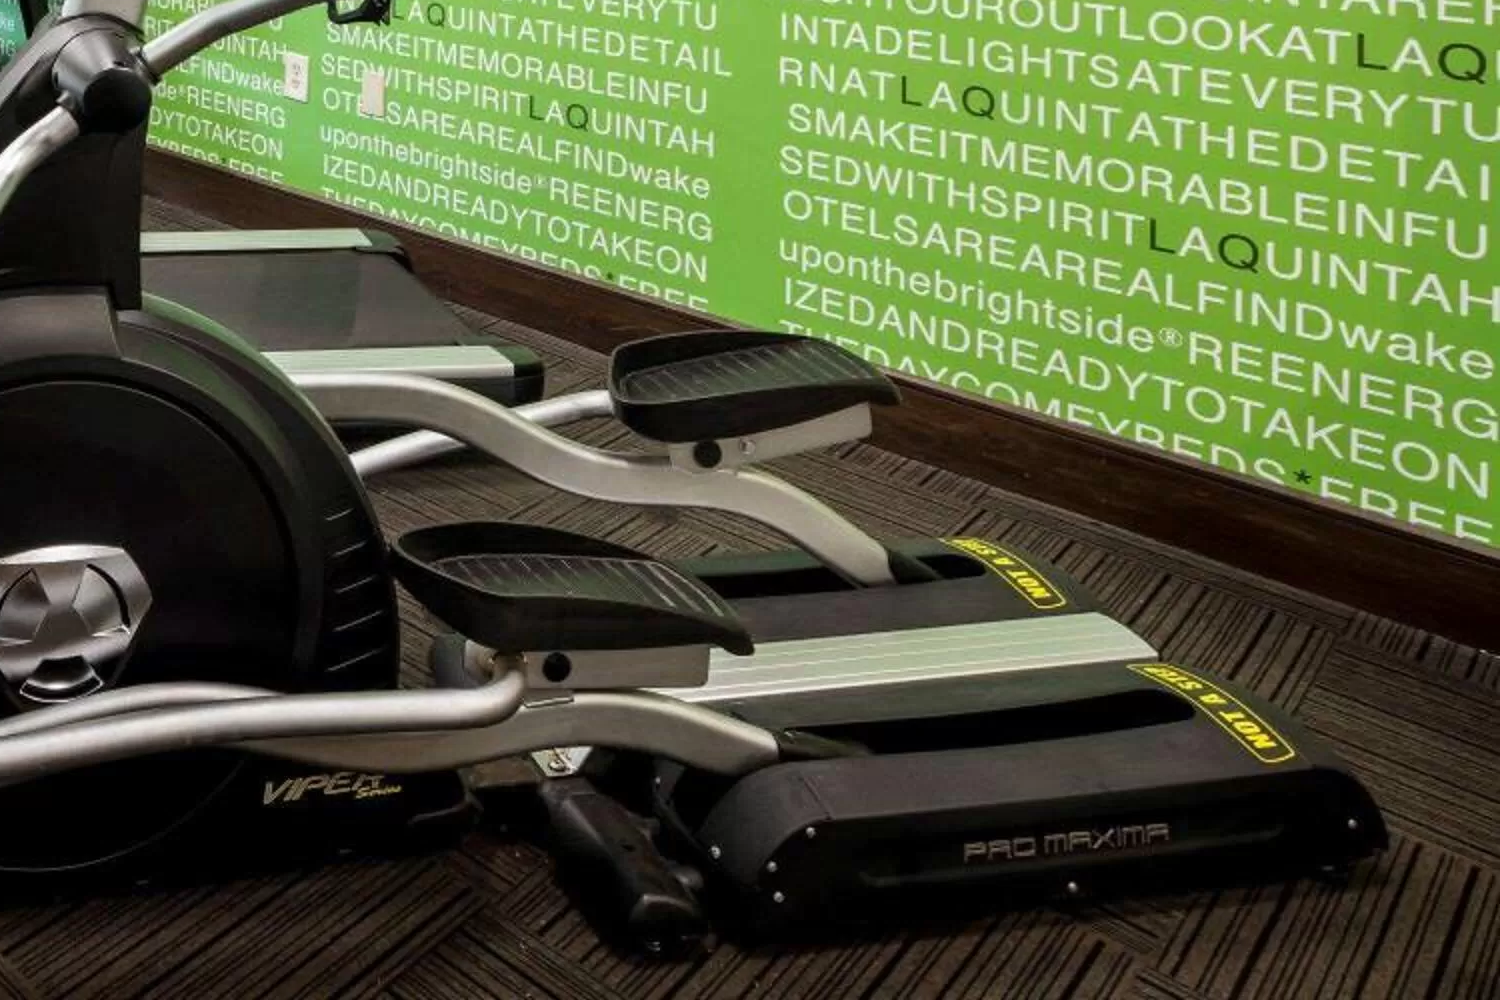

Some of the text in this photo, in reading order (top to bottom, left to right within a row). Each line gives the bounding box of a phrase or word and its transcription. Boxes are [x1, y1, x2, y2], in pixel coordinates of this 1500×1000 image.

[1005, 569, 1052, 599] NOT
[1199, 693, 1228, 705] A
[1219, 711, 1277, 749] NOT
